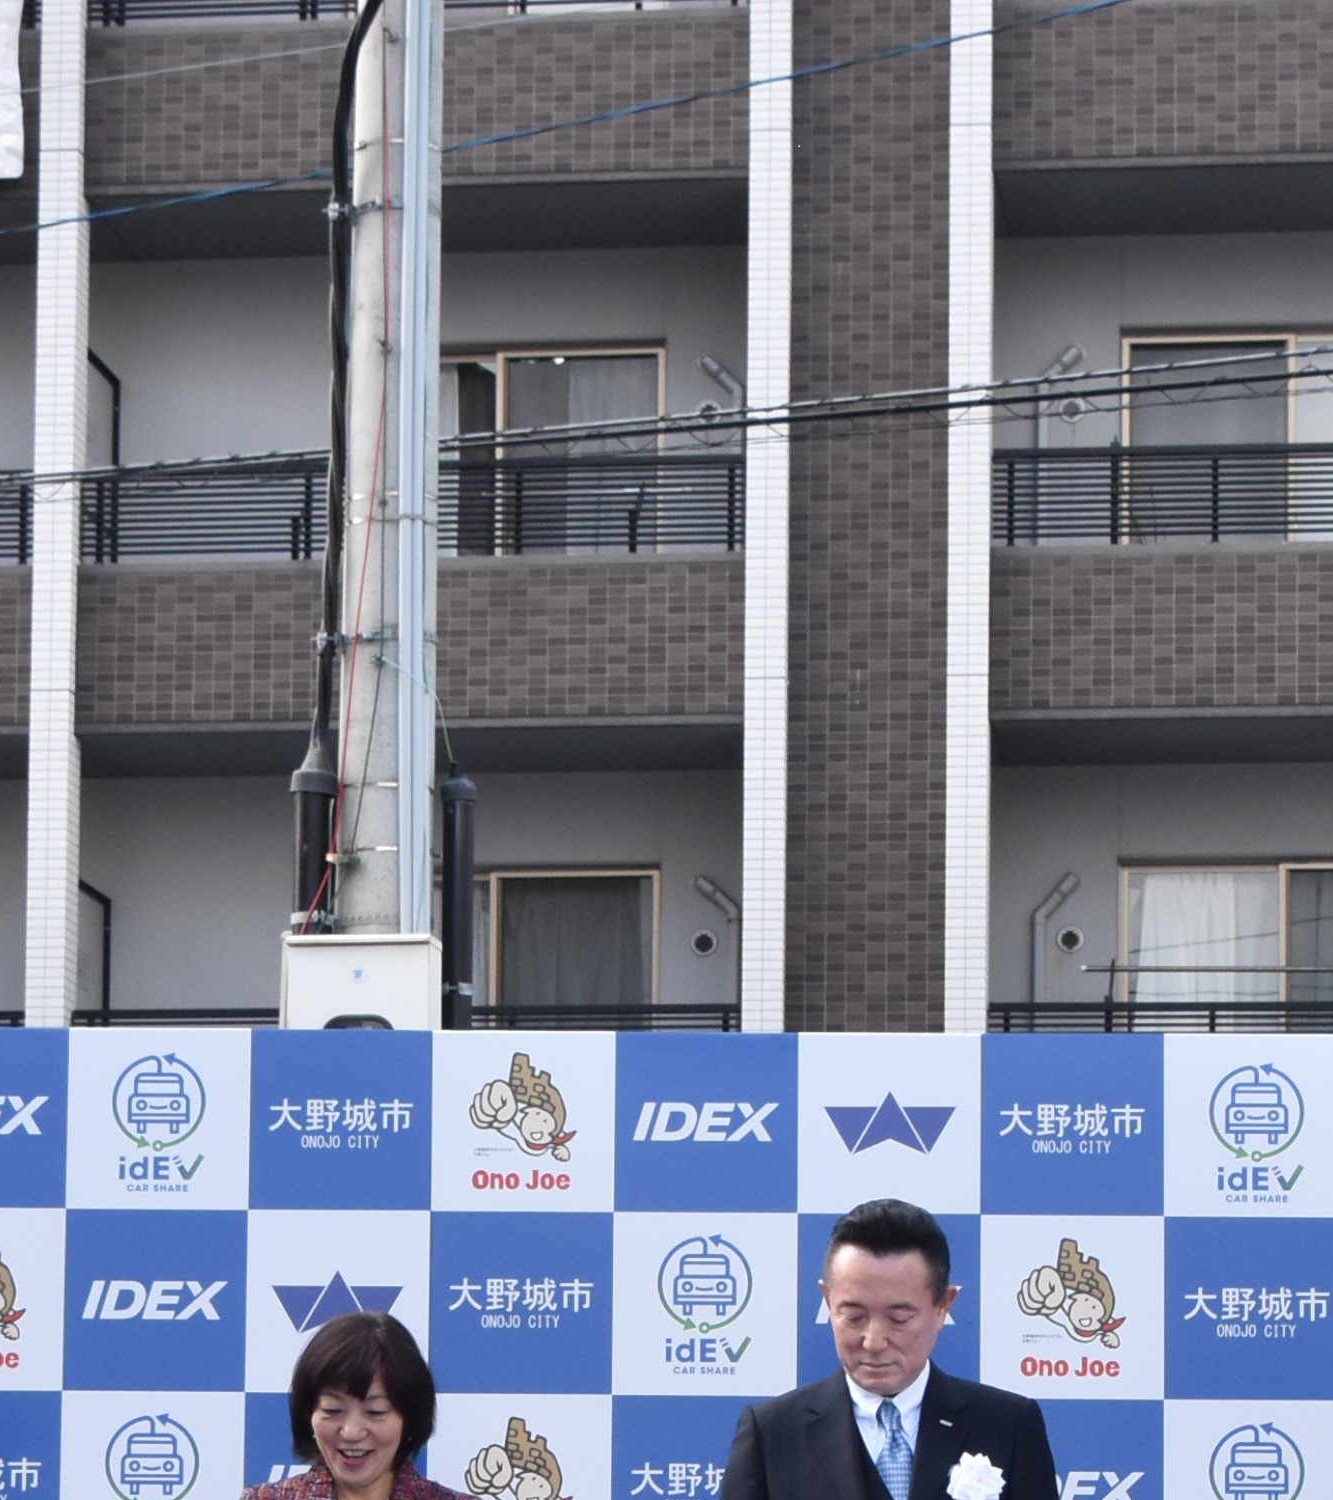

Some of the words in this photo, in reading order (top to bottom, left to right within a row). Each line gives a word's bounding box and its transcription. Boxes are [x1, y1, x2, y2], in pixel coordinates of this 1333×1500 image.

[270, 1099, 413, 1132] 大野城市
[634, 1102, 778, 1141] IDEX
[1000, 1104, 1145, 1137] 大野城市
[302, 1135, 340, 1148] ONOJO
[348, 1135, 379, 1148] CITY
[1032, 1140, 1072, 1153] ONOJO
[1080, 1140, 1111, 1153] CITY
[127, 1184, 148, 1192] CAR
[154, 1184, 188, 1192] SHARE
[473, 1170, 521, 1189] Ono
[529, 1171, 570, 1189] Joe
[82, 1281, 227, 1320] IDEX
[449, 1278, 593, 1312] 大野城市
[1185, 1287, 1329, 1321] 大野城市
[481, 1315, 520, 1328] ONOJO
[529, 1315, 559, 1328] CITY
[1217, 1324, 1256, 1337] ONOJO
[1264, 1324, 1296, 1337] CITY
[1021, 1357, 1070, 1376] Ono
[1078, 1357, 1120, 1376] Joe
